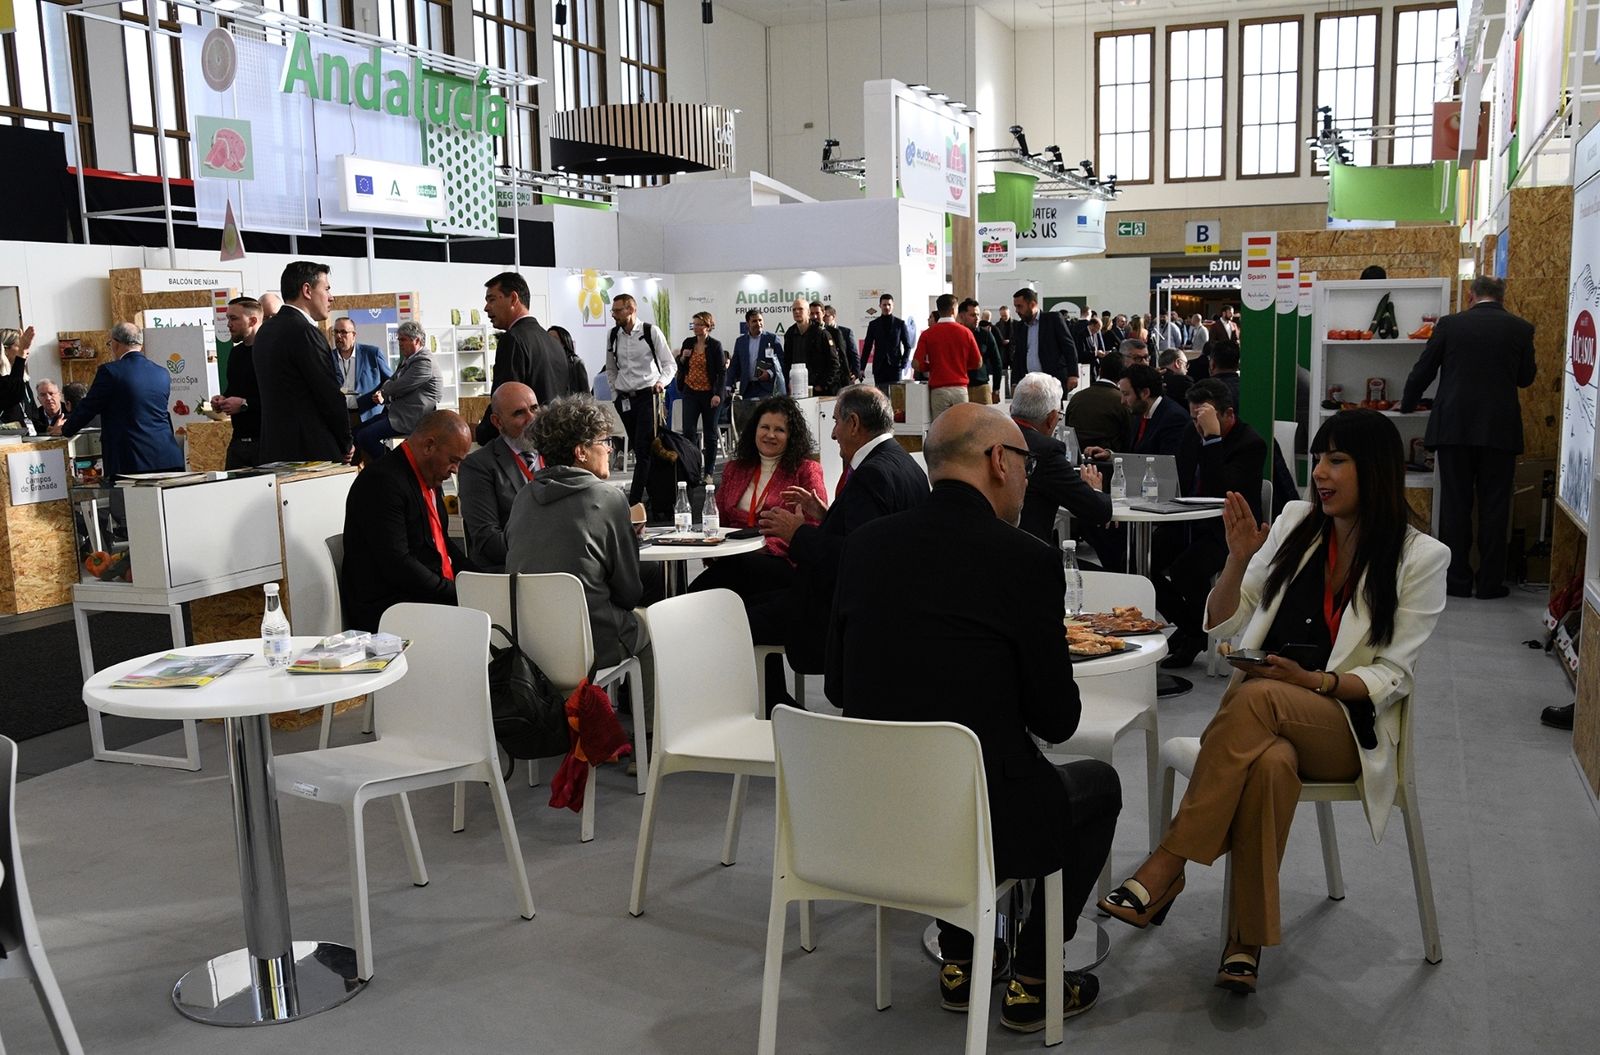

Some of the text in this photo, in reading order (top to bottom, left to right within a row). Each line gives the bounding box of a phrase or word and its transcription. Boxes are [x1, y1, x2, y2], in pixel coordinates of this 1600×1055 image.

[280, 31, 505, 136] Andalucía
[1032, 207, 1057, 220] ATER
[1041, 222, 1058, 239] US
[1196, 225, 1209, 243] B
